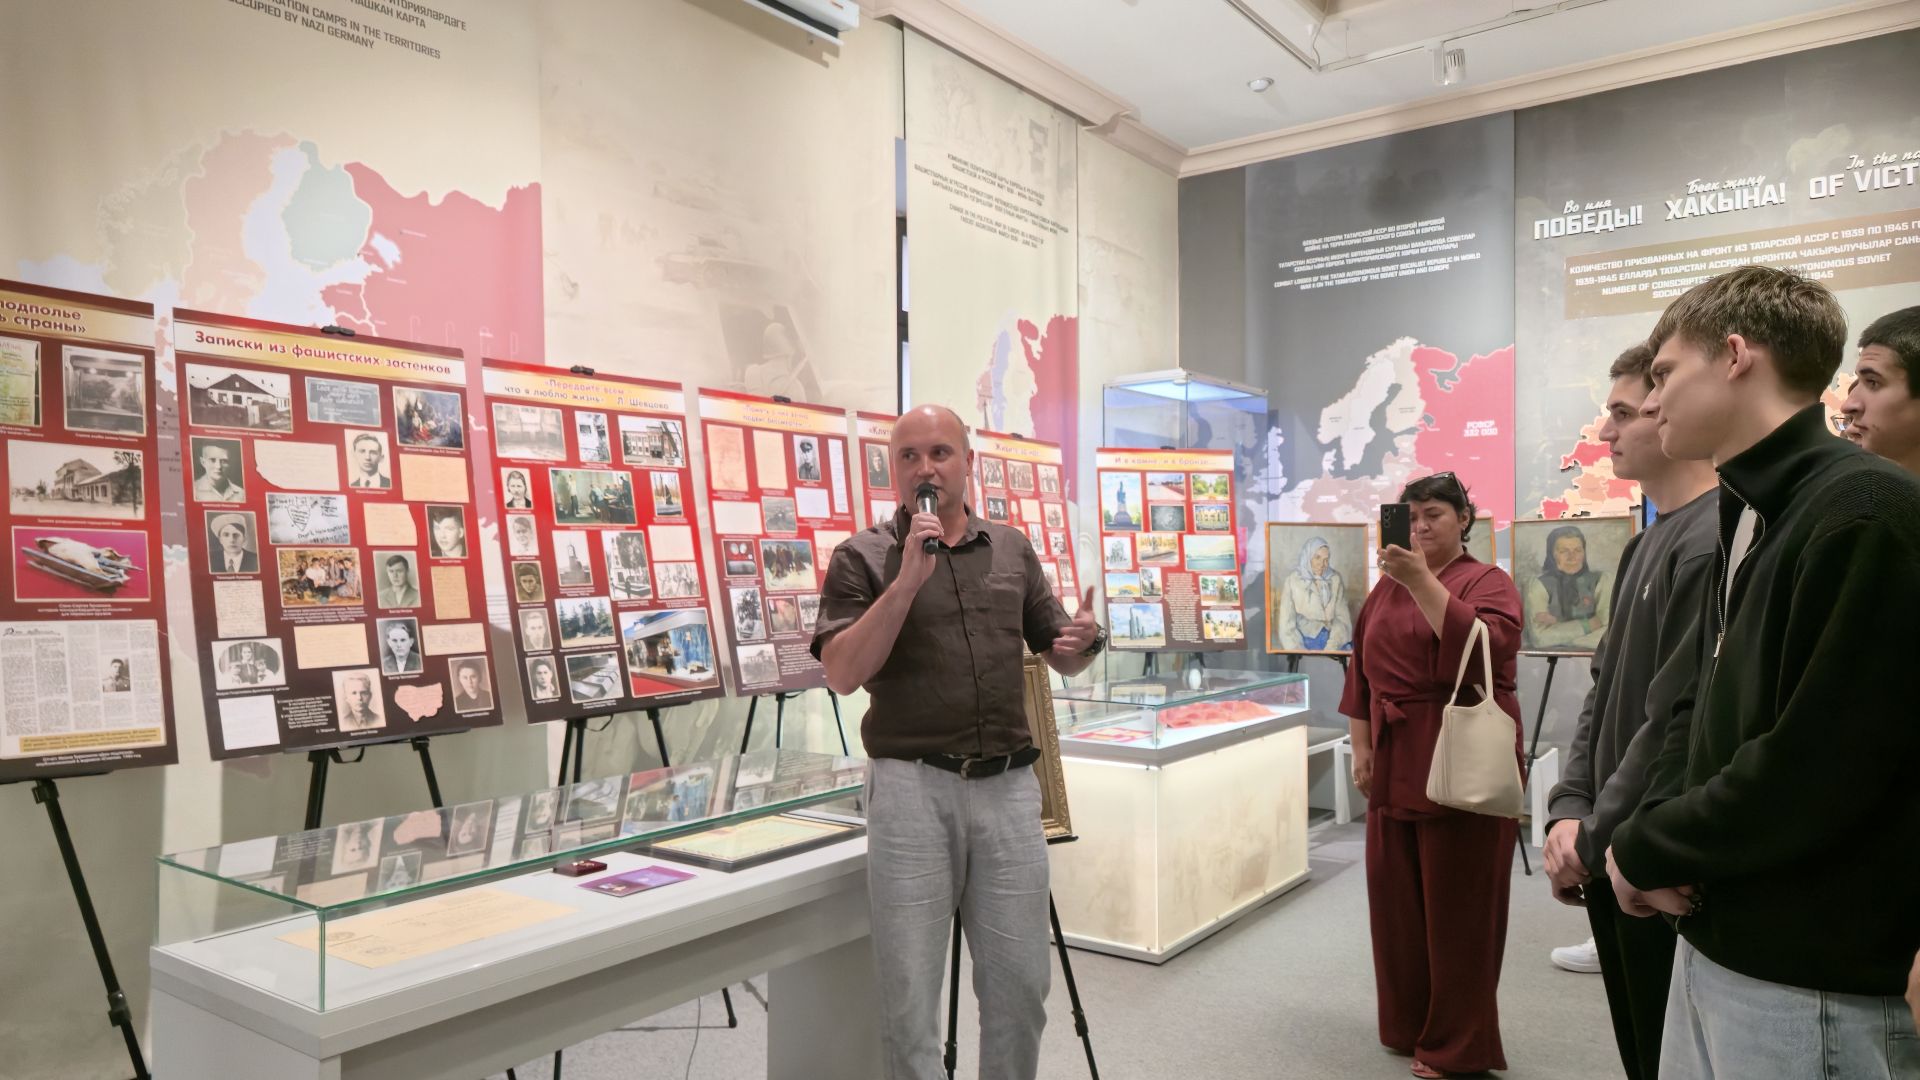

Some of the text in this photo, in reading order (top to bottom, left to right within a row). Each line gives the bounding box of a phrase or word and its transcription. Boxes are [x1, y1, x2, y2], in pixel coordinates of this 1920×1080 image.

[284, 10, 298, 24] BY
[301, 17, 325, 33] NAZI
[328, 26, 374, 48] GERMANY
[312, 7, 348, 27] CAMPS
[350, 20, 360, 32] IN
[362, 24, 381, 39] THE
[384, 31, 440, 59] TERRITORIES
[396, 10, 426, 28] КАРТА
[1846, 154, 1864, 170] In
[1872, 152, 1898, 166] the
[1809, 162, 1920, 200] OF VICT
[1563, 199, 1612, 214] Во имя
[1665, 182, 1786, 221] ХАКЫНА!
[1373, 226, 1387, 235] АССР
[1534, 204, 1643, 240] ПОБЕДЫ!
[1570, 261, 1622, 274] КОЛИЧЕСТВО
[1624, 253, 1685, 266] ПРИЗВАННЫХ
[1686, 250, 1699, 258] НА
[1701, 246, 1732, 257] ФРОНТ
[1736, 244, 1747, 253] ИЗ
[1750, 234, 1802, 250] ТАТАРСКОЙ
[1804, 234, 1830, 244] АССР
[1842, 228, 1864, 238] 1939
[1868, 226, 1881, 235] ПО
[1884, 222, 1908, 232] 1945
[1576, 274, 1617, 286] 1939-1945
[1619, 268, 1658, 280] ЕЛЛАРДА
[1660, 262, 1706, 276] ТАТАРСТАН
[1752, 252, 1798, 264] ФРОНТКА
[1800, 239, 1892, 257] ЧАКЫРЫЛУЧЫЛАР
[1330, 272, 1346, 280] TATAR
[1346, 267, 1380, 278] AUTONOMOUS
[1381, 264, 1399, 273] SOVIET
[1400, 260, 1426, 270] SOCIALIST
[1426, 256, 1453, 266] REPUBLIC
[1460, 252, 1480, 261] WORLD
[1335, 276, 1361, 285] TERRITORY
[1428, 263, 1450, 272] EUROPE
[1602, 284, 1637, 296] NUMBER
[1639, 282, 1650, 290] OF
[1857, 252, 1892, 264] SOVIET
[1811, 270, 1834, 280] 1945
[14, 316, 86, 333] страны»
[195, 330, 451, 374] Записки из фашистских застенков
[533, 390, 568, 402] люблю
